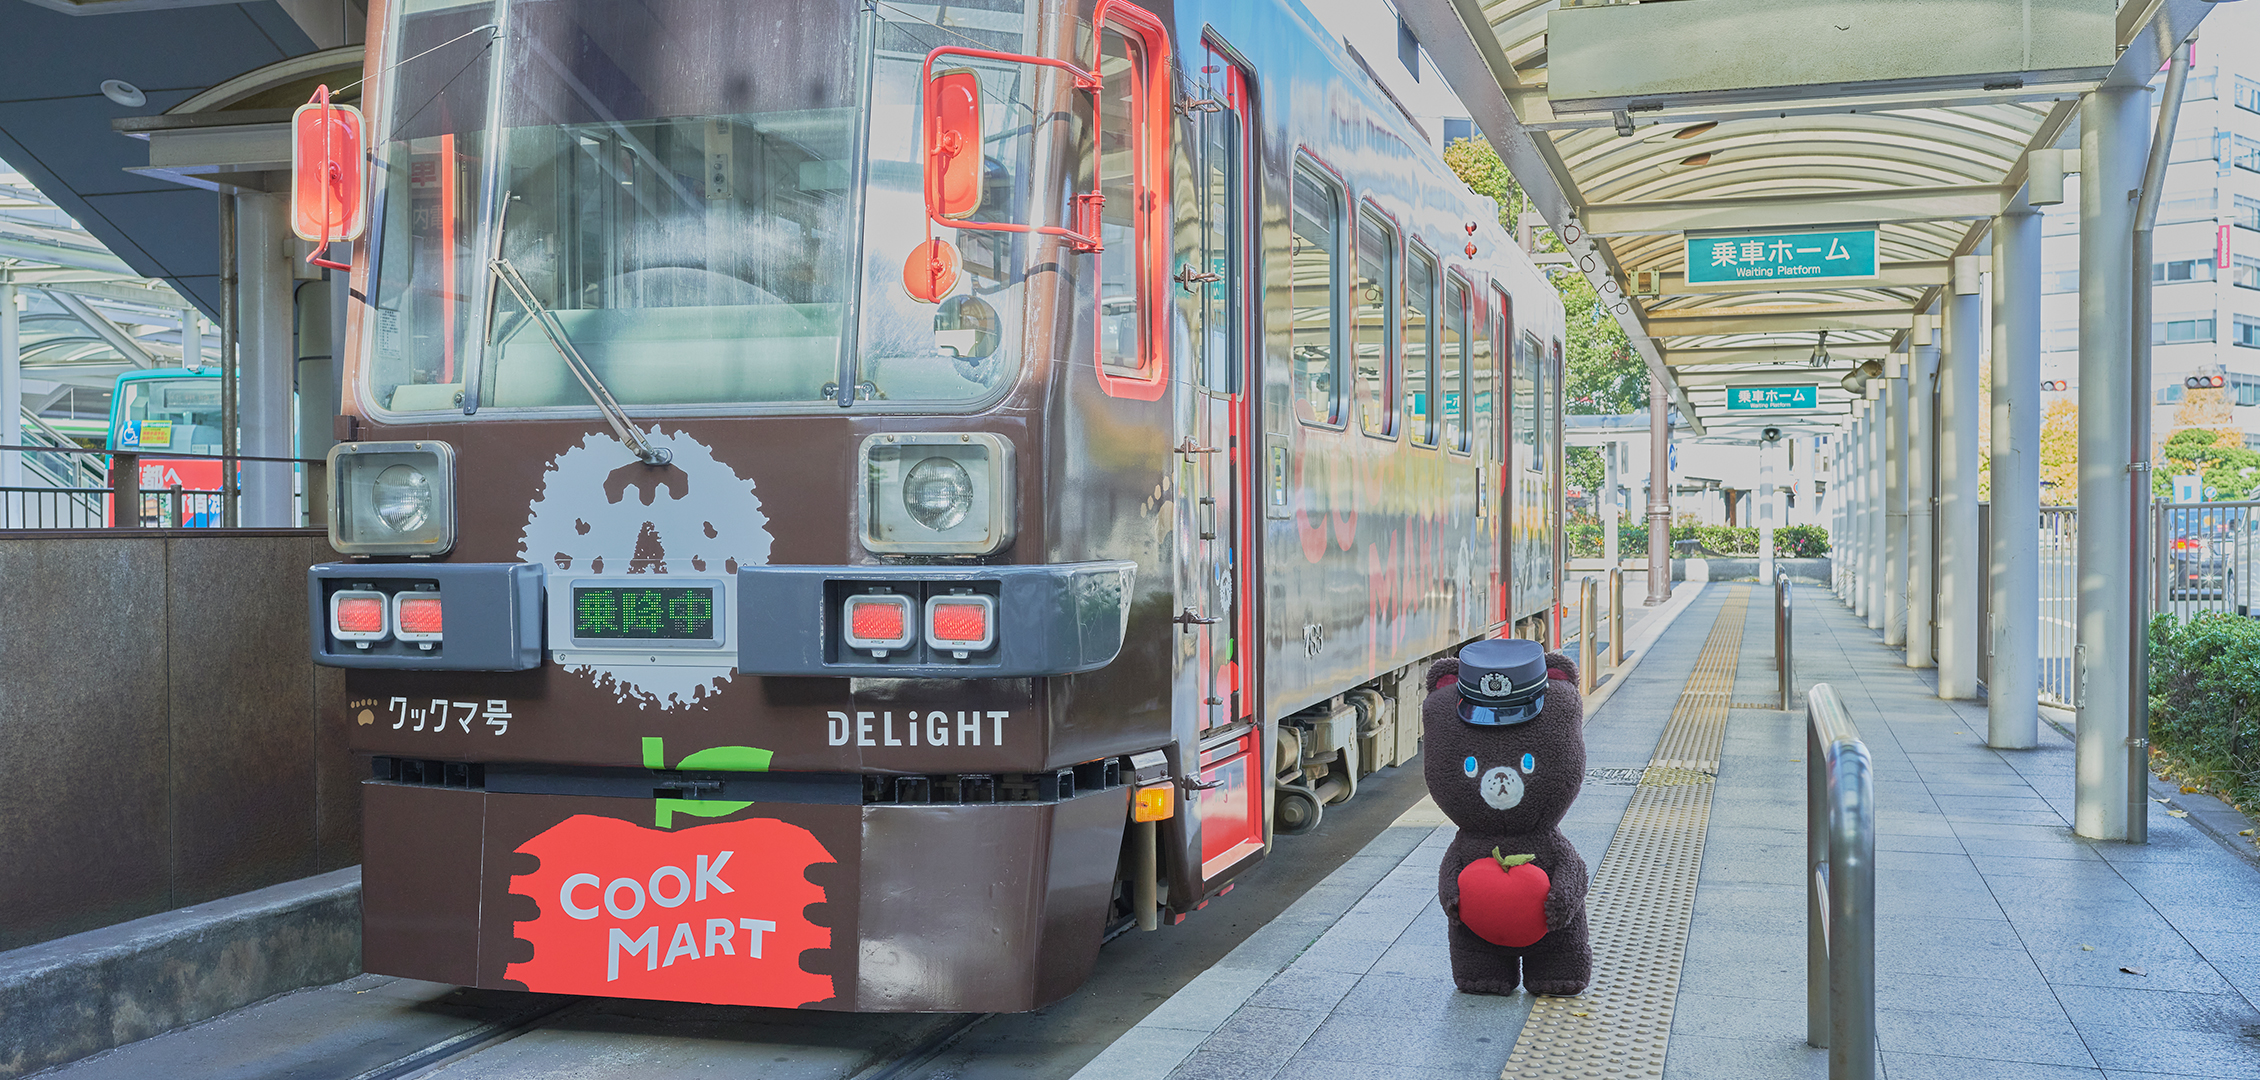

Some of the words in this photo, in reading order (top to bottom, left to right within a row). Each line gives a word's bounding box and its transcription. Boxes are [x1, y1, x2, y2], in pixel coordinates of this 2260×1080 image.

[1711, 237, 1850, 267] 乗車ホーム
[1736, 267, 1773, 277] Waiting
[1777, 265, 1821, 275] Platform
[1738, 389, 1805, 403] 乗車ホーム
[138, 464, 182, 490] 都へ
[576, 589, 713, 634] 乗降中
[389, 697, 512, 735] クックマ号
[559, 850, 735, 920] COOK
[607, 918, 776, 982] MART
